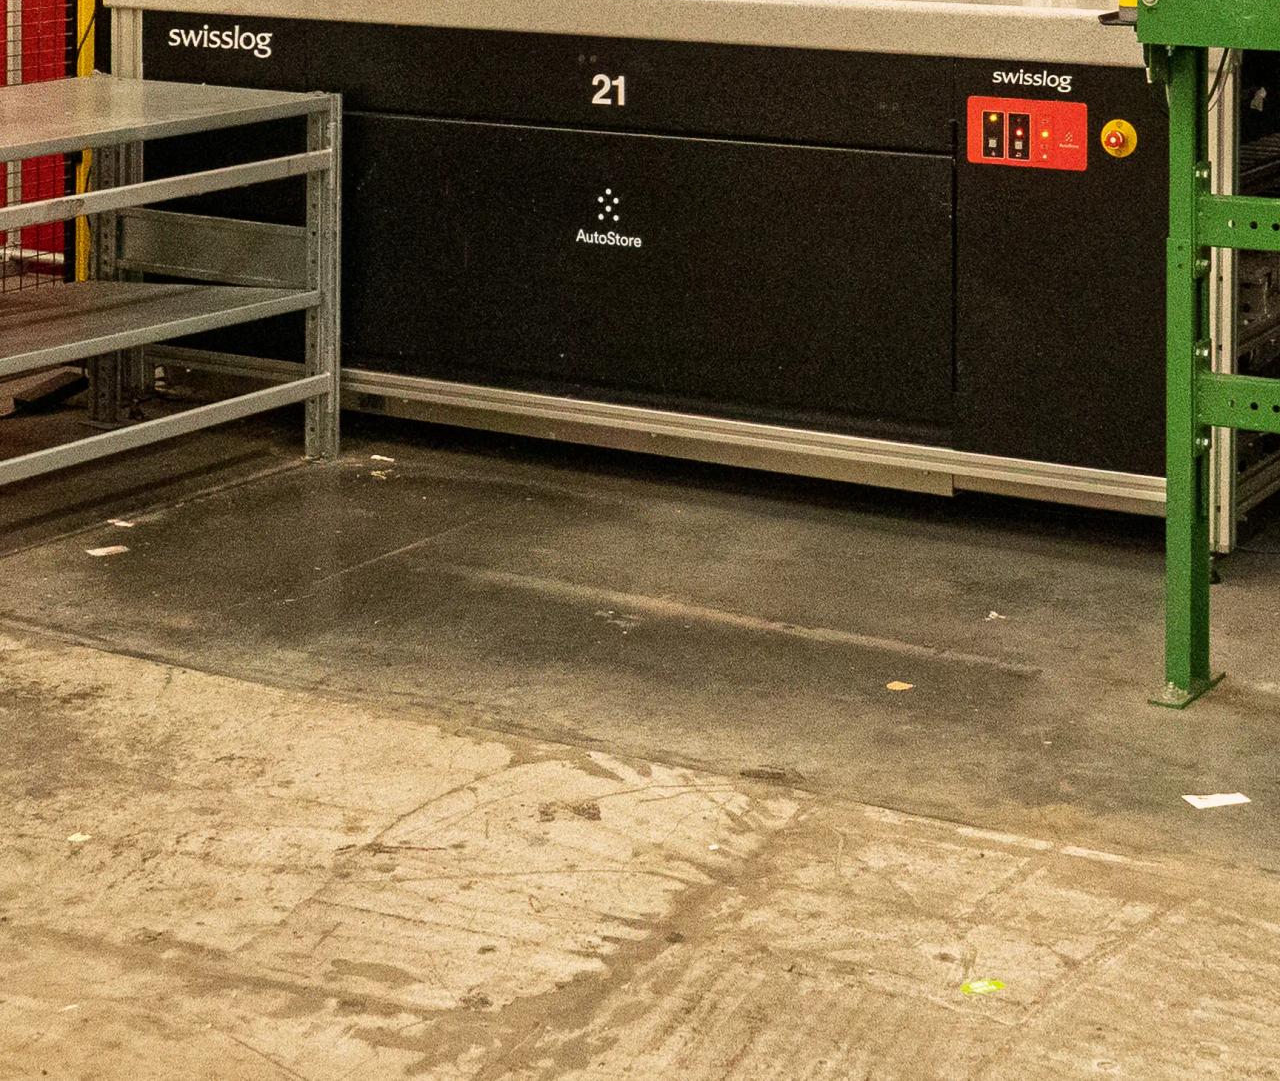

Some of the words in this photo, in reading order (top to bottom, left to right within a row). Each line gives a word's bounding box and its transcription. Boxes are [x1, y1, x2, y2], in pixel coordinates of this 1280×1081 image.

[167, 24, 273, 59] swisslog
[591, 73, 625, 106] 21
[992, 69, 1073, 93] swisslog
[575, 228, 642, 248] AutoStore
